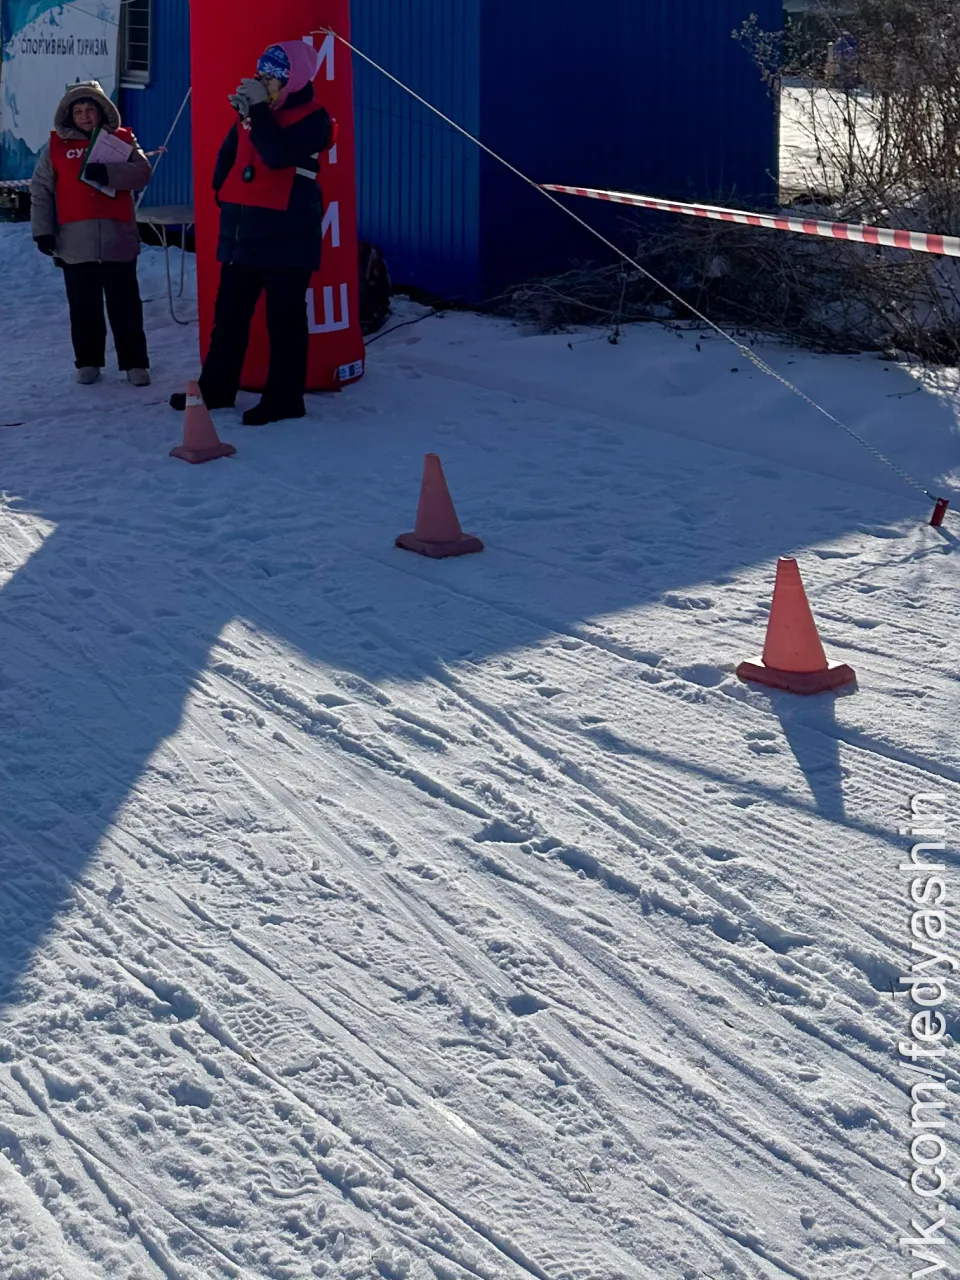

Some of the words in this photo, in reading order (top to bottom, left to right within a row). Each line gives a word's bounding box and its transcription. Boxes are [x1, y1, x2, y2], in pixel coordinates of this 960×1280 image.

[20, 35, 74, 55] СПОРТИВНЫЙ
[76, 38, 109, 56] ТУРИЗМ
[66, 147, 88, 159] СУ
